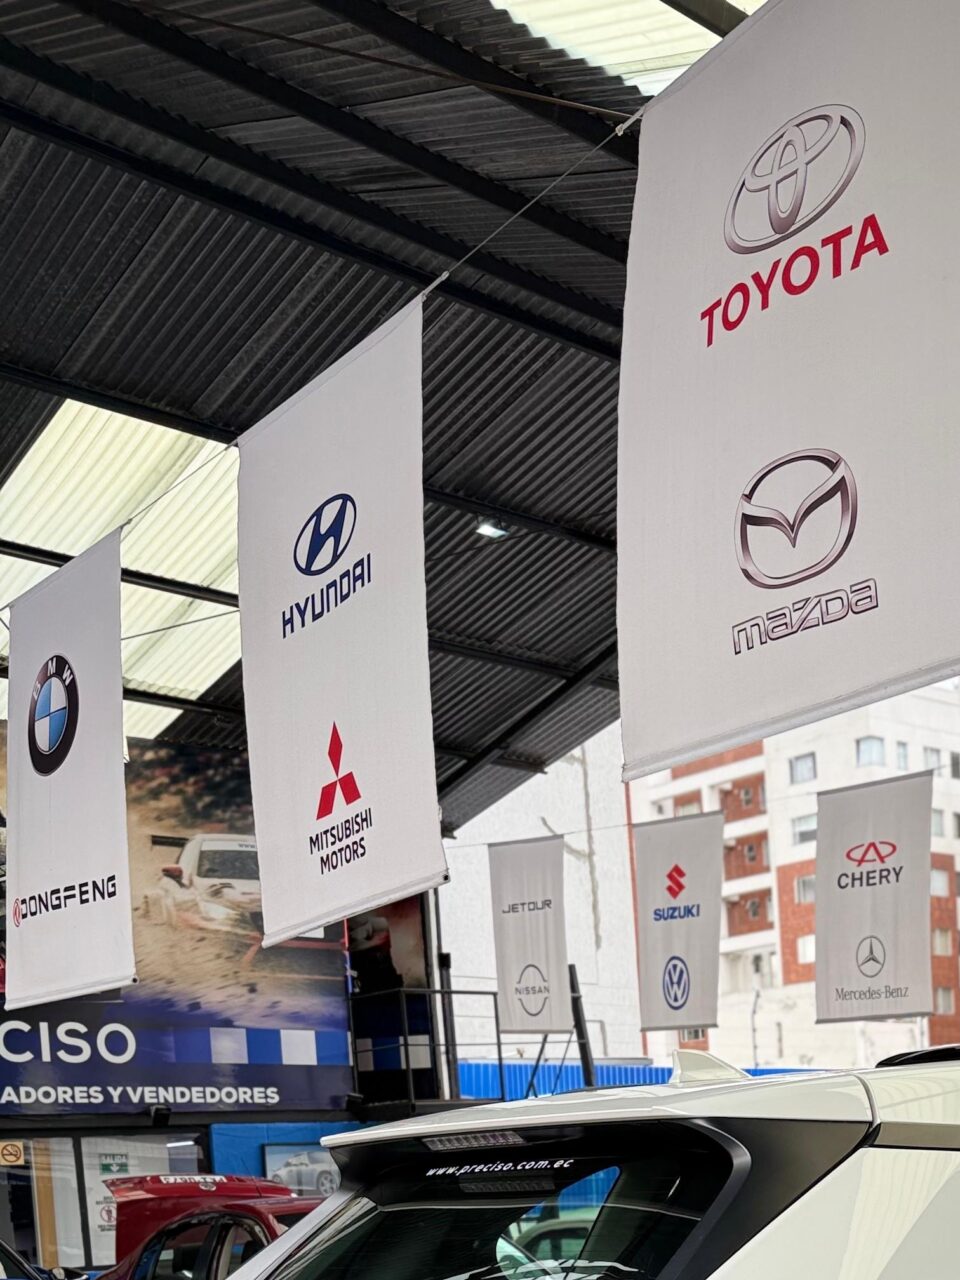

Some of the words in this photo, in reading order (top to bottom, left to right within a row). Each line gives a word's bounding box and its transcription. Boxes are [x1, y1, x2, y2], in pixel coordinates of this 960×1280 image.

[699, 213, 890, 348] TOYOTA
[281, 552, 372, 640] HYUNDAI
[32, 656, 76, 700] BMW
[308, 806, 374, 856] MITSUBISHI
[319, 835, 367, 876] MOTORS
[836, 865, 905, 890] CHERY
[20, 874, 118, 920] DONGFENG
[501, 898, 553, 915] JETOUR
[653, 903, 701, 923] SUZUKI
[514, 985, 551, 996] NISSAN
[834, 984, 910, 1002] Mercedes-Benz
[0, 1019, 137, 1065] CISO
[1, 1085, 105, 1104] ADORES
[106, 1085, 124, 1104] Y
[126, 1085, 281, 1104] VENDEDORES
[425, 1158, 575, 1177] www.preciso.com.ec
